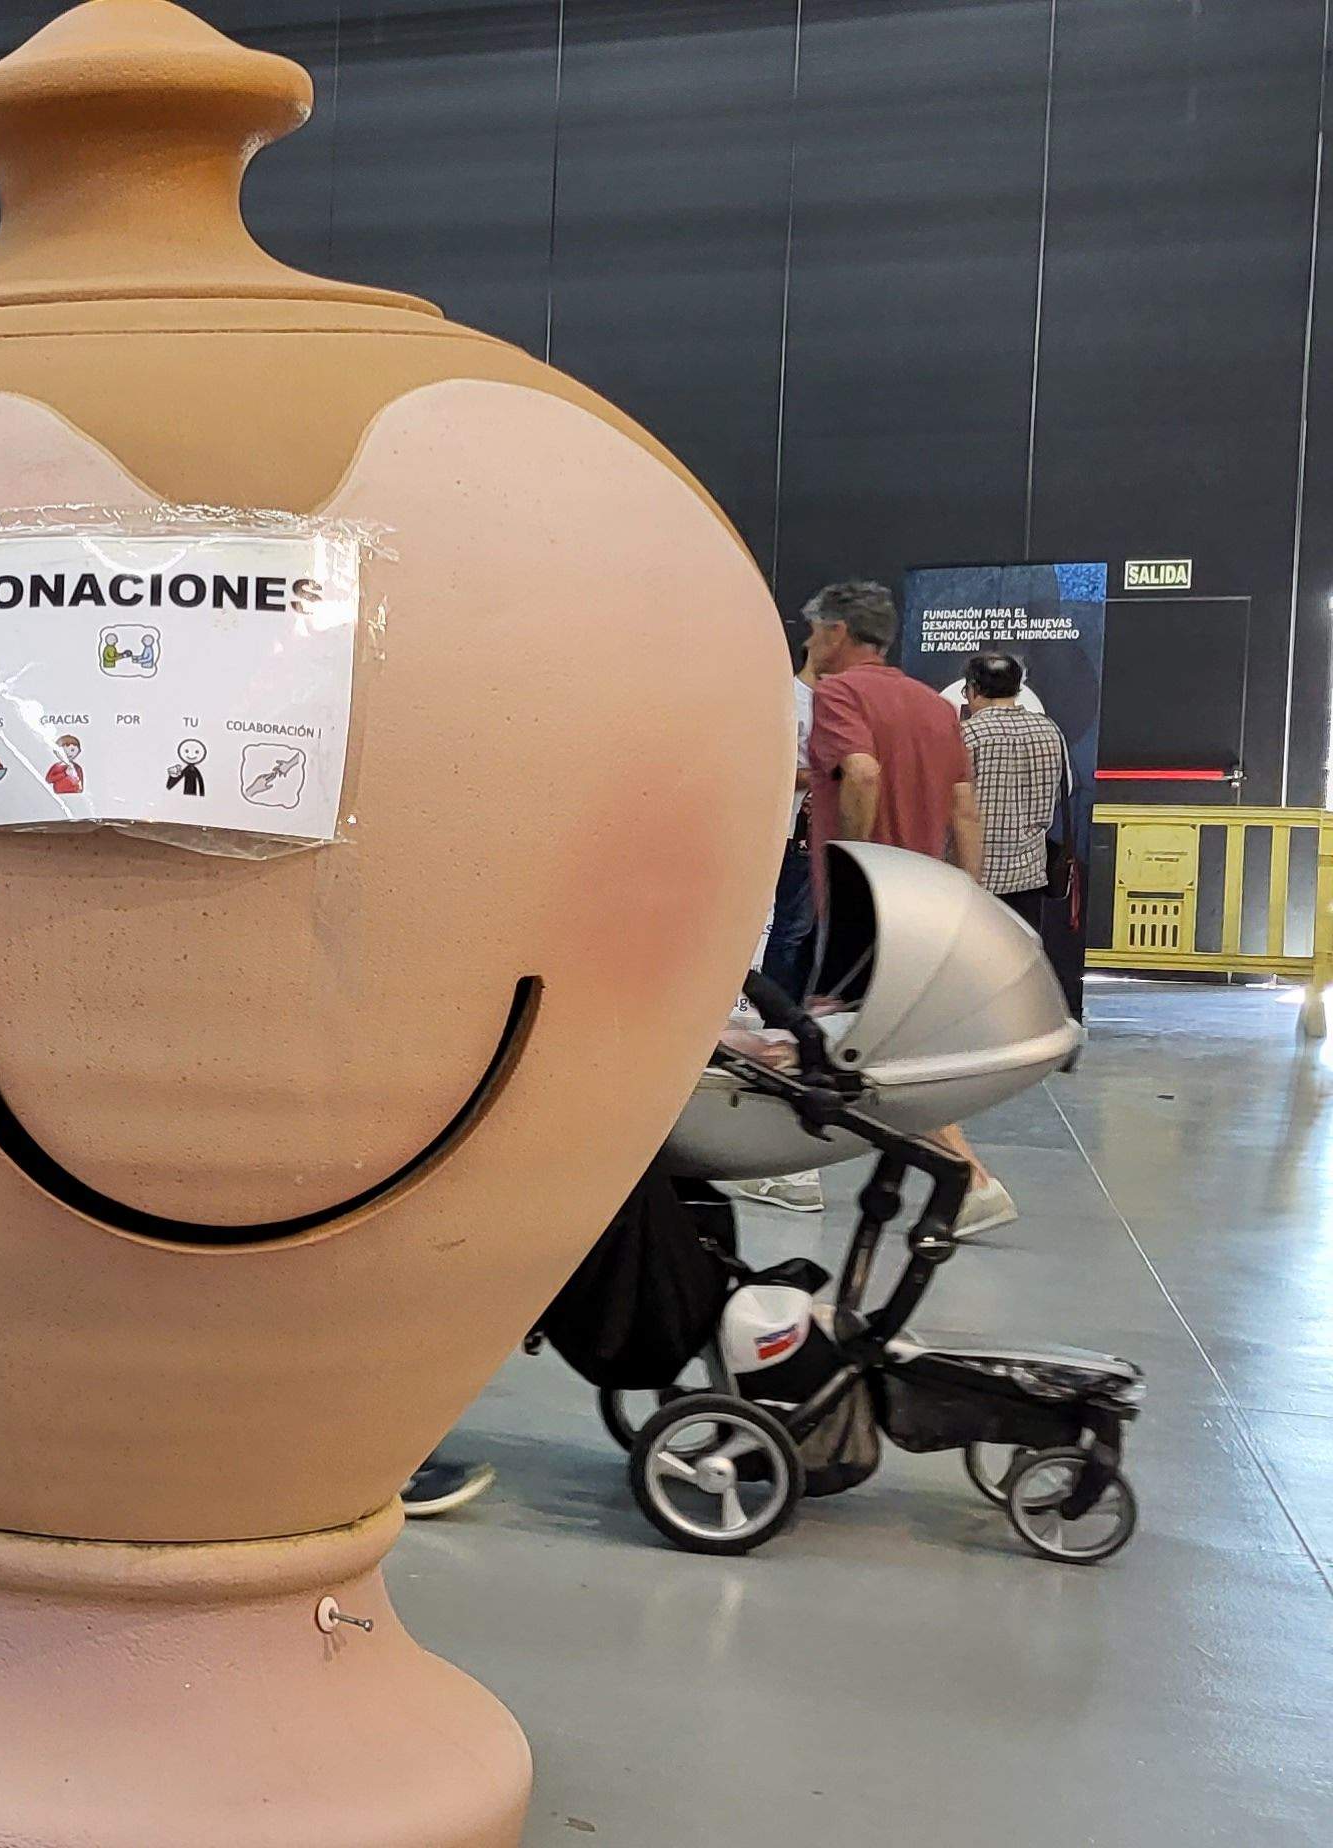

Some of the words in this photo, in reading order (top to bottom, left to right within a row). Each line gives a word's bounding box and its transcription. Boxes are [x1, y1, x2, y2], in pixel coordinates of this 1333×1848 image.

[1128, 564, 1188, 585] SALIDA
[922, 606, 983, 620] FUNDACIÓN
[984, 608, 1012, 619] PARA
[1014, 607, 1027, 618] EL
[921, 618, 989, 631] DESARROLLO
[990, 619, 1005, 630] DE
[1007, 618, 1028, 630] LAS
[1030, 617, 1073, 630] NUEVAS
[921, 628, 991, 641] TECNOLOGÍAS
[993, 629, 1014, 640] DEL
[1016, 627, 1080, 640] HIDRÓGENO
[920, 641, 935, 652] EN
[936, 638, 981, 652] ARAGÓN
[39, 714, 90, 726] GRACIAS
[116, 714, 141, 725] POR
[183, 717, 199, 728] TU
[226, 719, 314, 738] COLABORACIÓN
